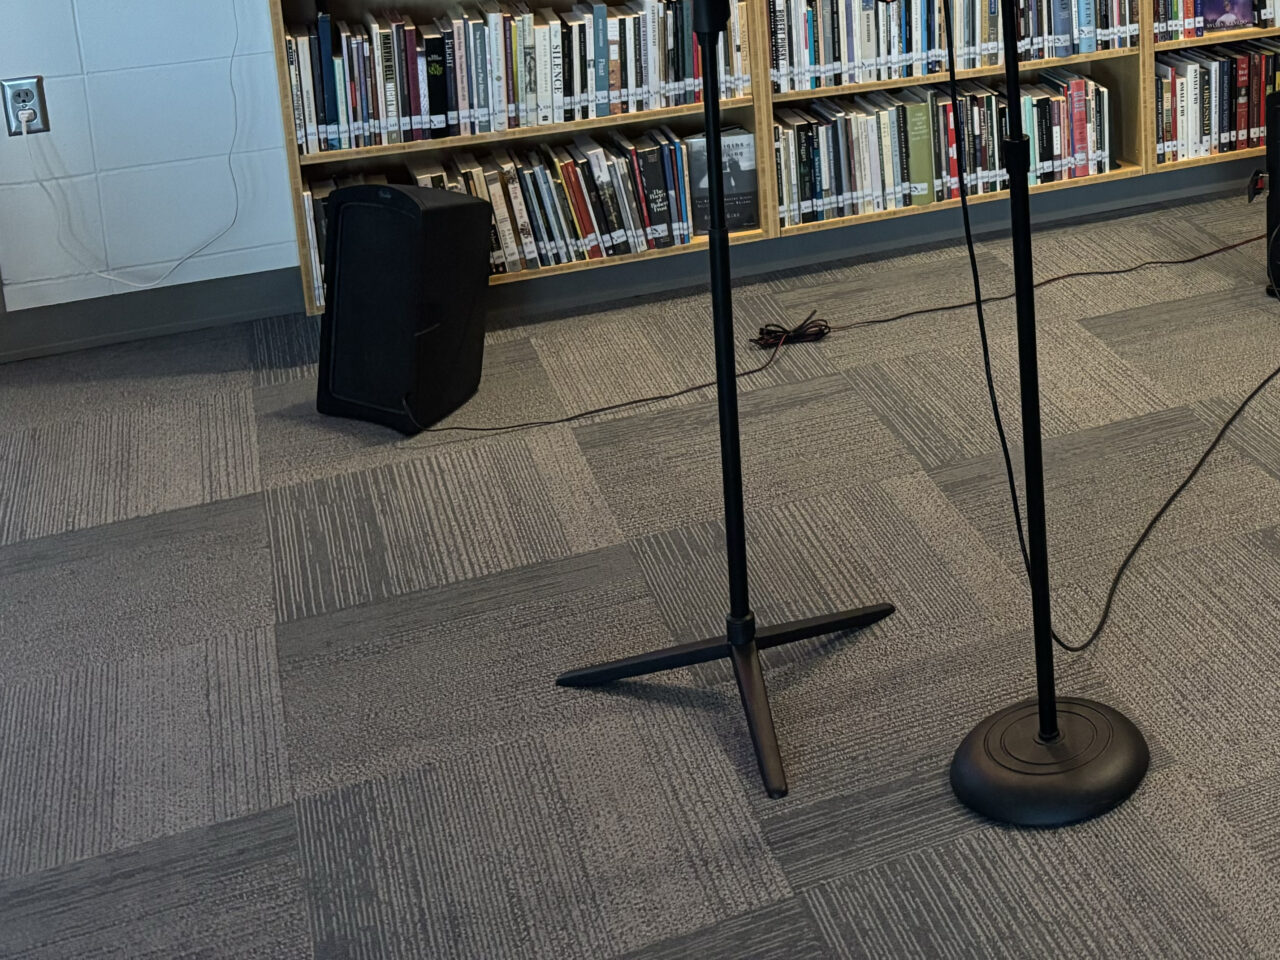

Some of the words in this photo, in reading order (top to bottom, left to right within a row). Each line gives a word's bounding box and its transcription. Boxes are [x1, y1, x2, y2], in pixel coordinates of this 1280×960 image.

[775, 9, 786, 31] ROBERT
[382, 34, 393, 63] MARVIN
[777, 32, 787, 62] PINSKY
[384, 64, 394, 81] BELL
[552, 44, 563, 94] SILENCE
[1202, 85, 1212, 134] OBSESSED
